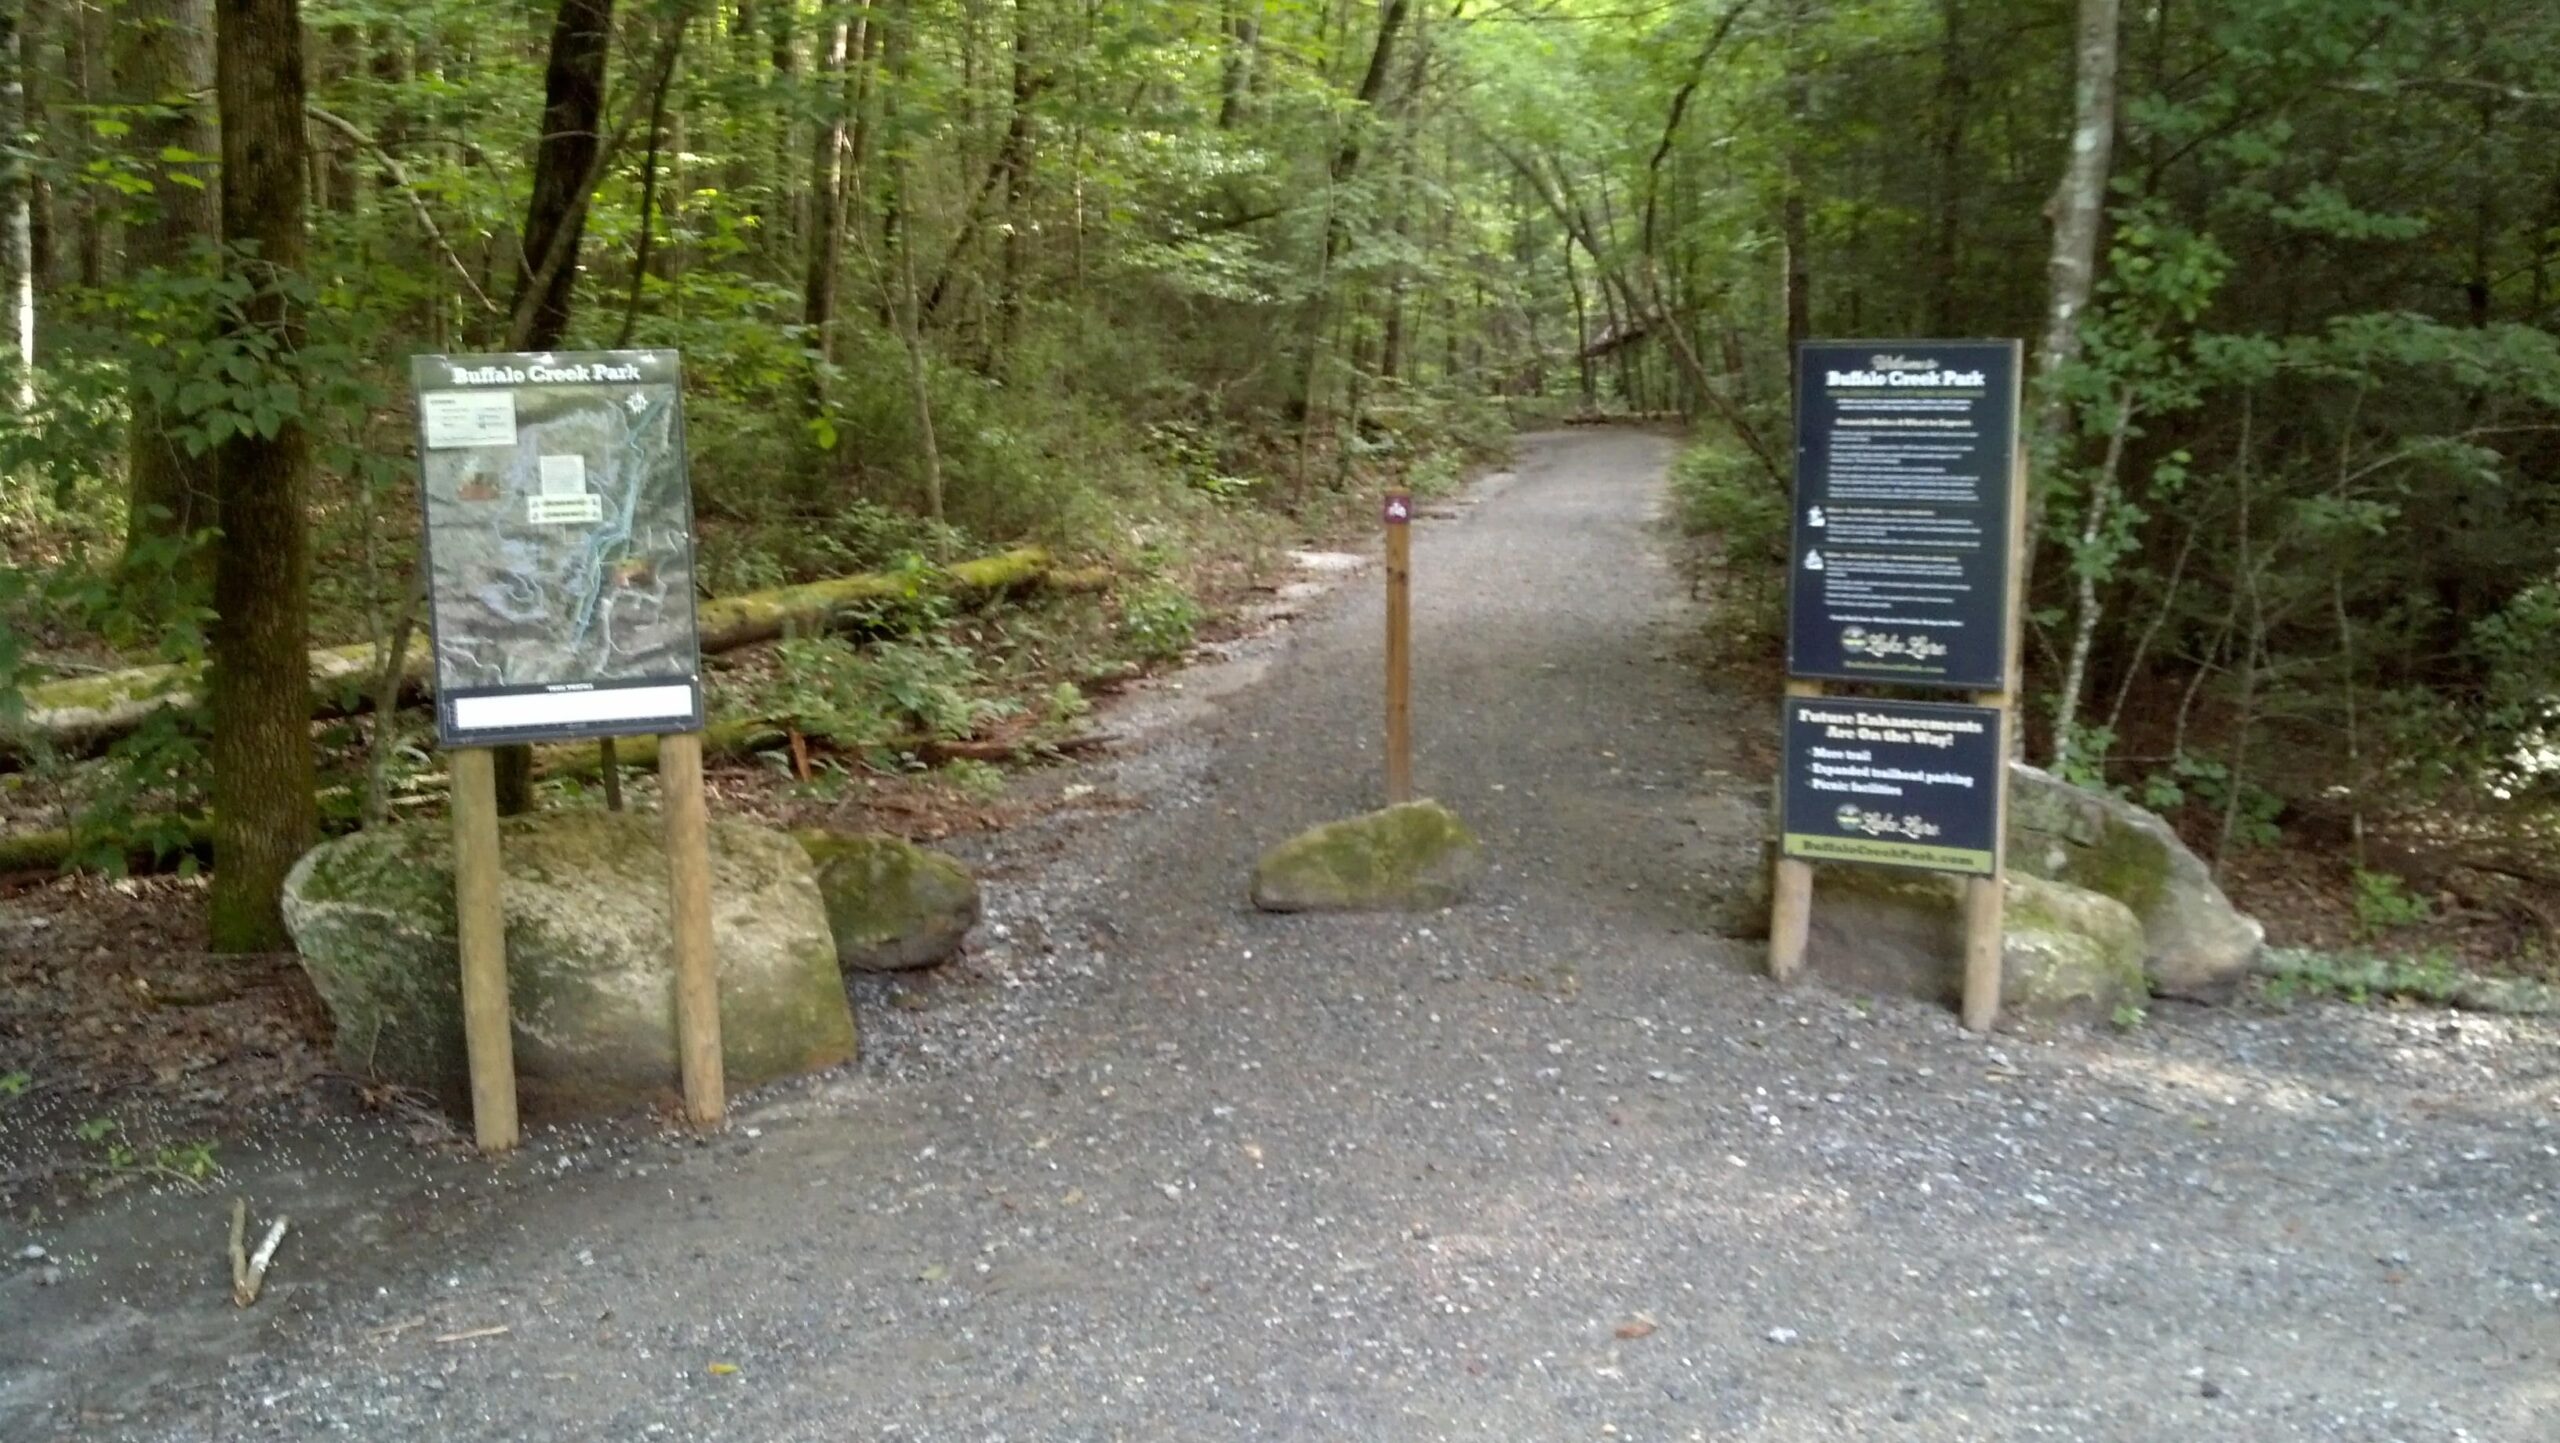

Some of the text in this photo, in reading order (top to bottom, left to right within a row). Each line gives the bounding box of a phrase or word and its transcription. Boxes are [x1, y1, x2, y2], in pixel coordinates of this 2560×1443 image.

[452, 362, 641, 385] Buffalo Creek Park
[1825, 370, 1986, 387] Buffalo Creek Park
[1798, 708, 1984, 734] Future Enhancements
[1825, 725, 1954, 749] Are On the Way!
[1812, 746, 1872, 762] More trail
[1811, 762, 1974, 788] Expanded trailhead parking
[1811, 778, 1903, 796] Picnic facilities
